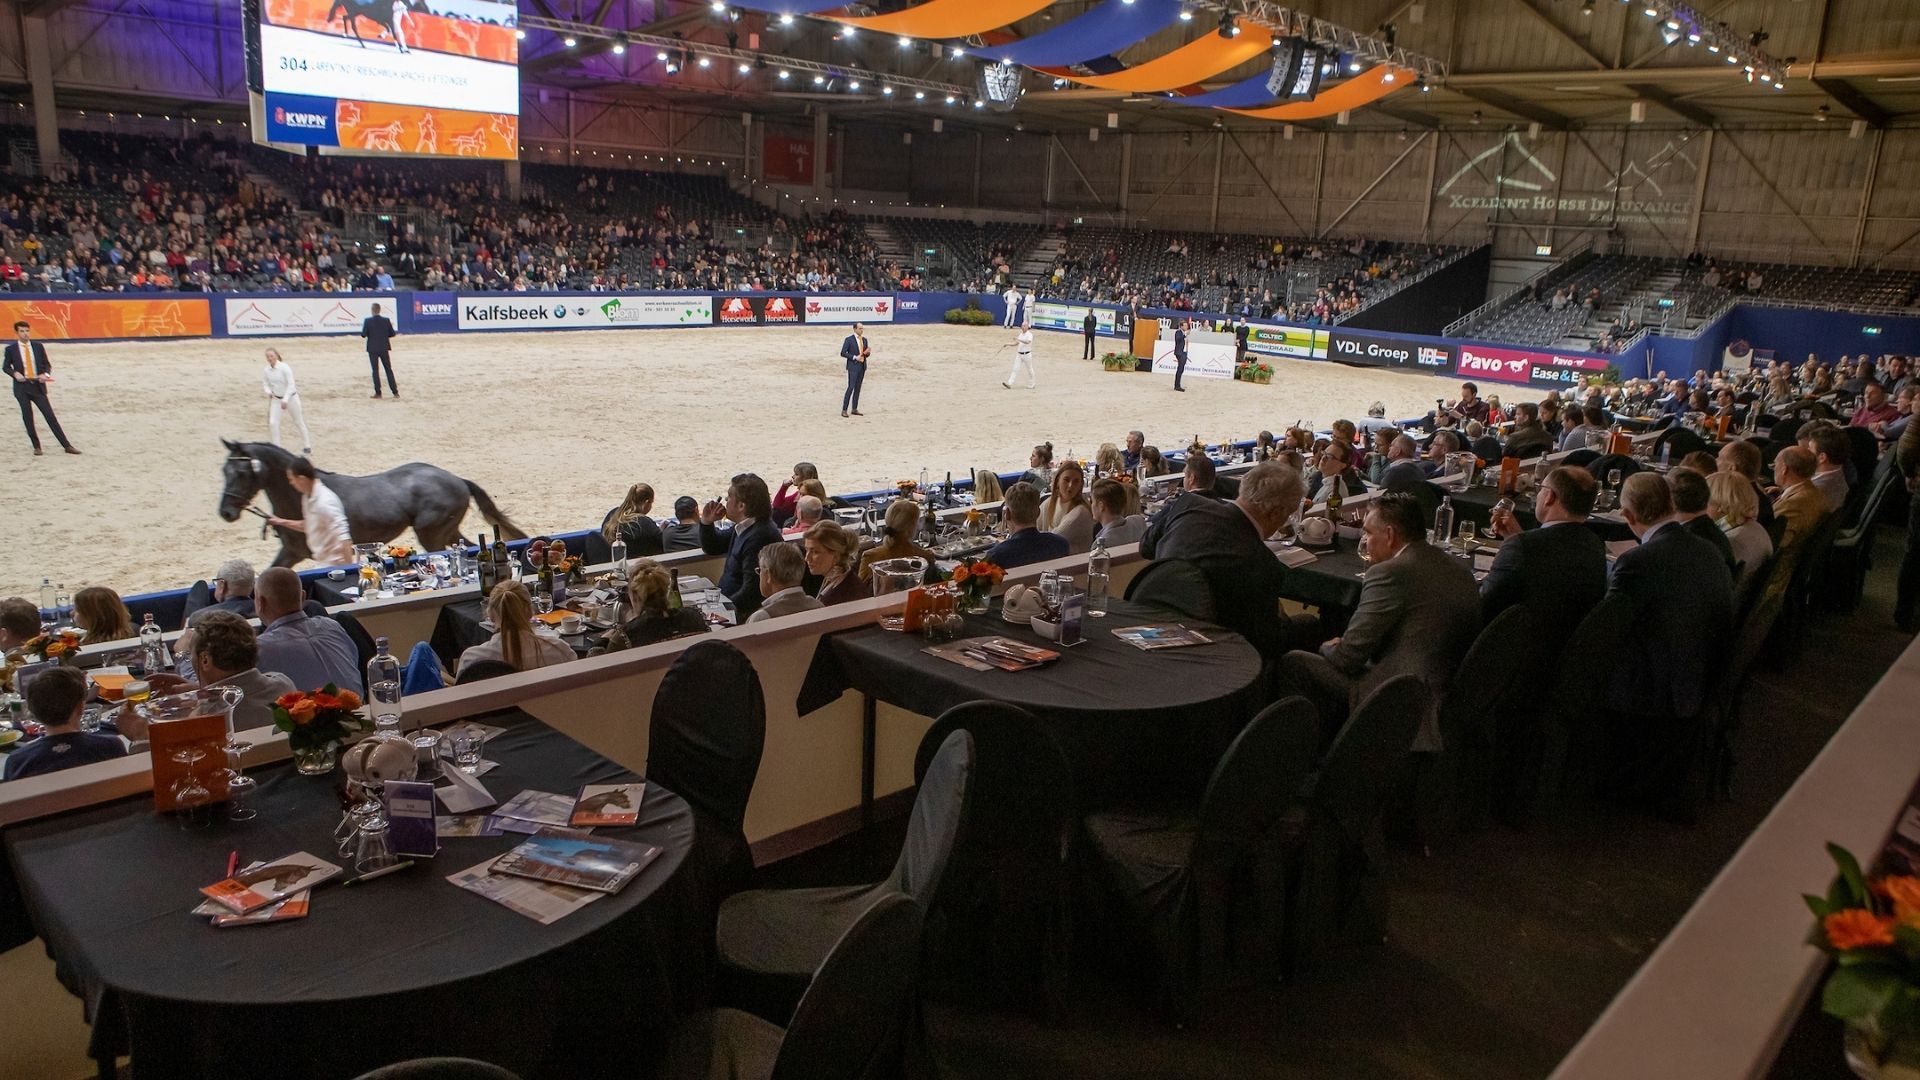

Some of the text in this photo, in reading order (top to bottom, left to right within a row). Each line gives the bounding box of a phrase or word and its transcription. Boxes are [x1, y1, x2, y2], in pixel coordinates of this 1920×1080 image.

[279, 56, 307, 72] 304
[286, 111, 328, 126] KWPN
[789, 143, 809, 156] HAL
[796, 157, 804, 173] 1
[1532, 196, 1586, 212] HORSE
[422, 304, 452, 313] KWPN
[466, 305, 549, 321] Kalfsbeek
[607, 304, 640, 319] Blom
[721, 315, 757, 323] Horseworld
[1258, 332, 1283, 341] KOLTEC
[1336, 340, 1409, 362] VDL Groep
[1417, 347, 1439, 365] VDL
[1461, 352, 1503, 372] Pavo
[1552, 356, 1573, 366] Pavo
[1532, 367, 1560, 380] Ease
[1559, 370, 1570, 382] &
